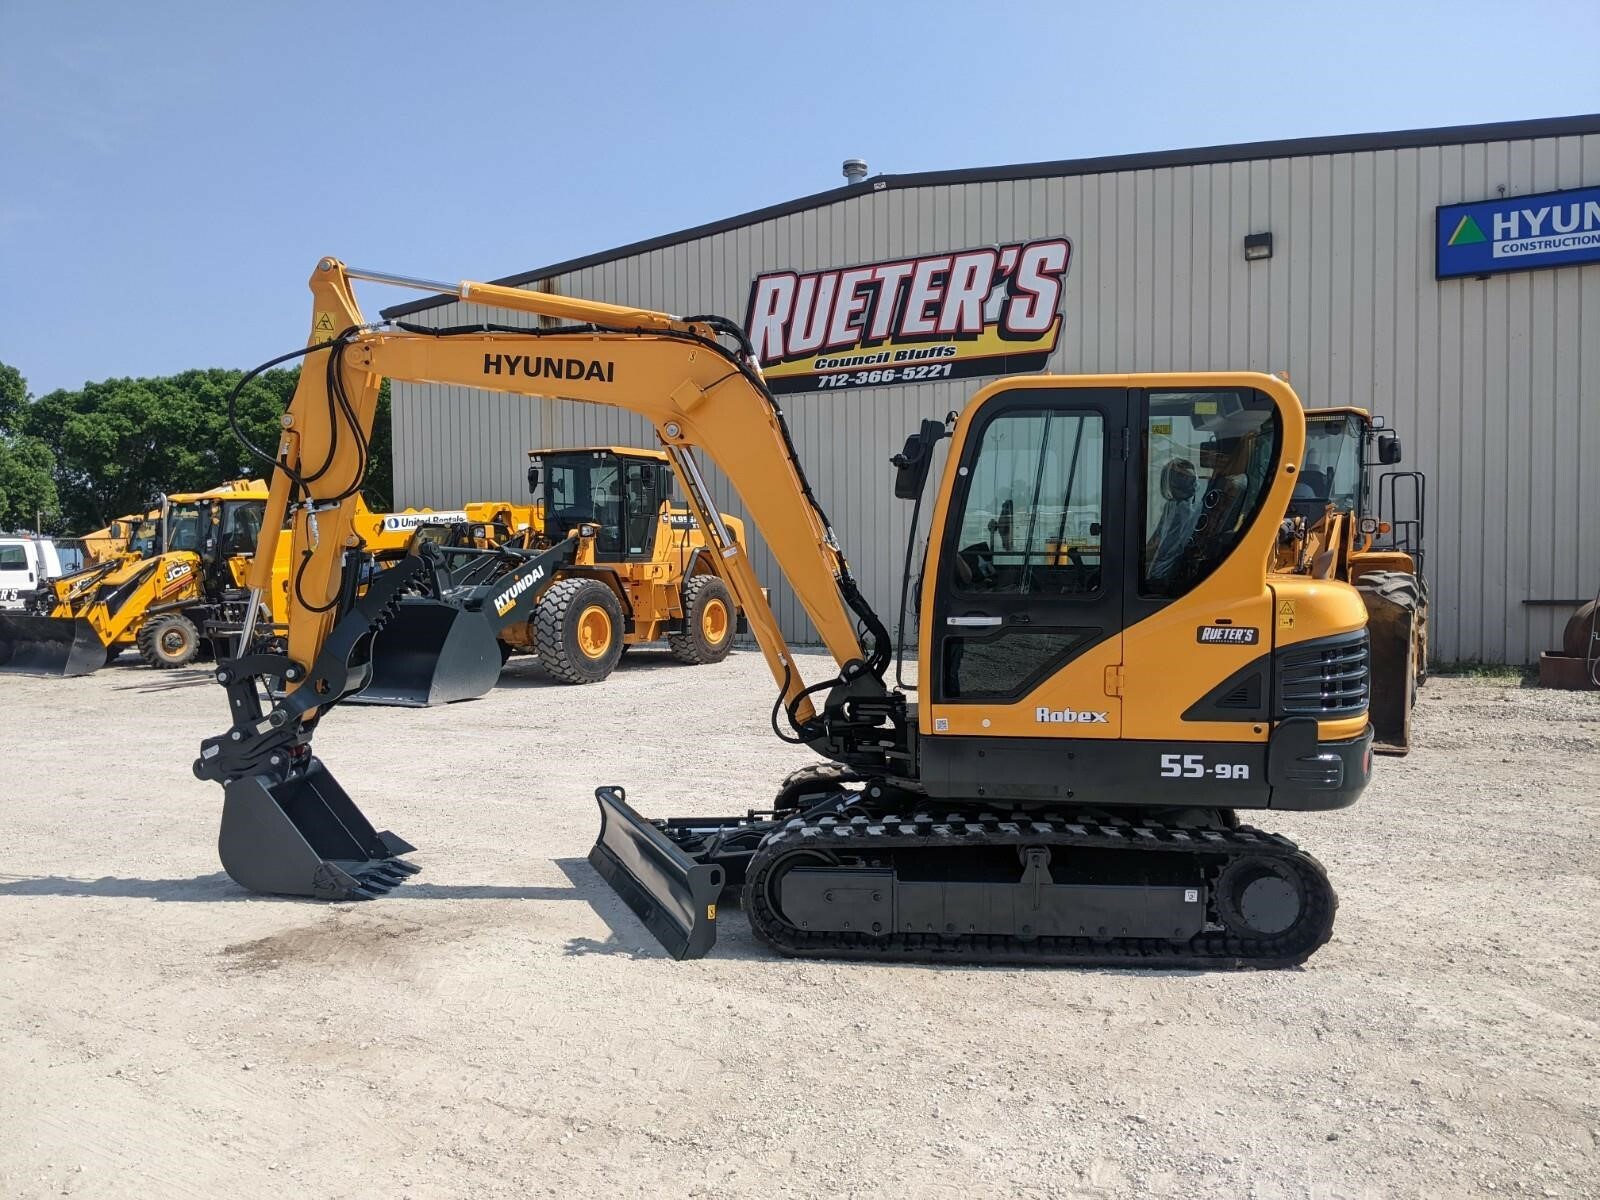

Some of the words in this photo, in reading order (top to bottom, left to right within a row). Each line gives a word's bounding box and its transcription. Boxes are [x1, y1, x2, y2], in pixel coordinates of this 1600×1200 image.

[748, 240, 1070, 363] RUETER'S
[484, 353, 614, 382] HYUNDAI
[814, 352, 890, 370] Council
[894, 346, 956, 362] Bluffs
[818, 363, 953, 388] 712-366-5221
[493, 565, 545, 611] HYUNDAI
[1201, 627, 1254, 642] RUETER'S
[1035, 706, 1109, 723] Robex
[1160, 753, 1250, 779] 55-9A
